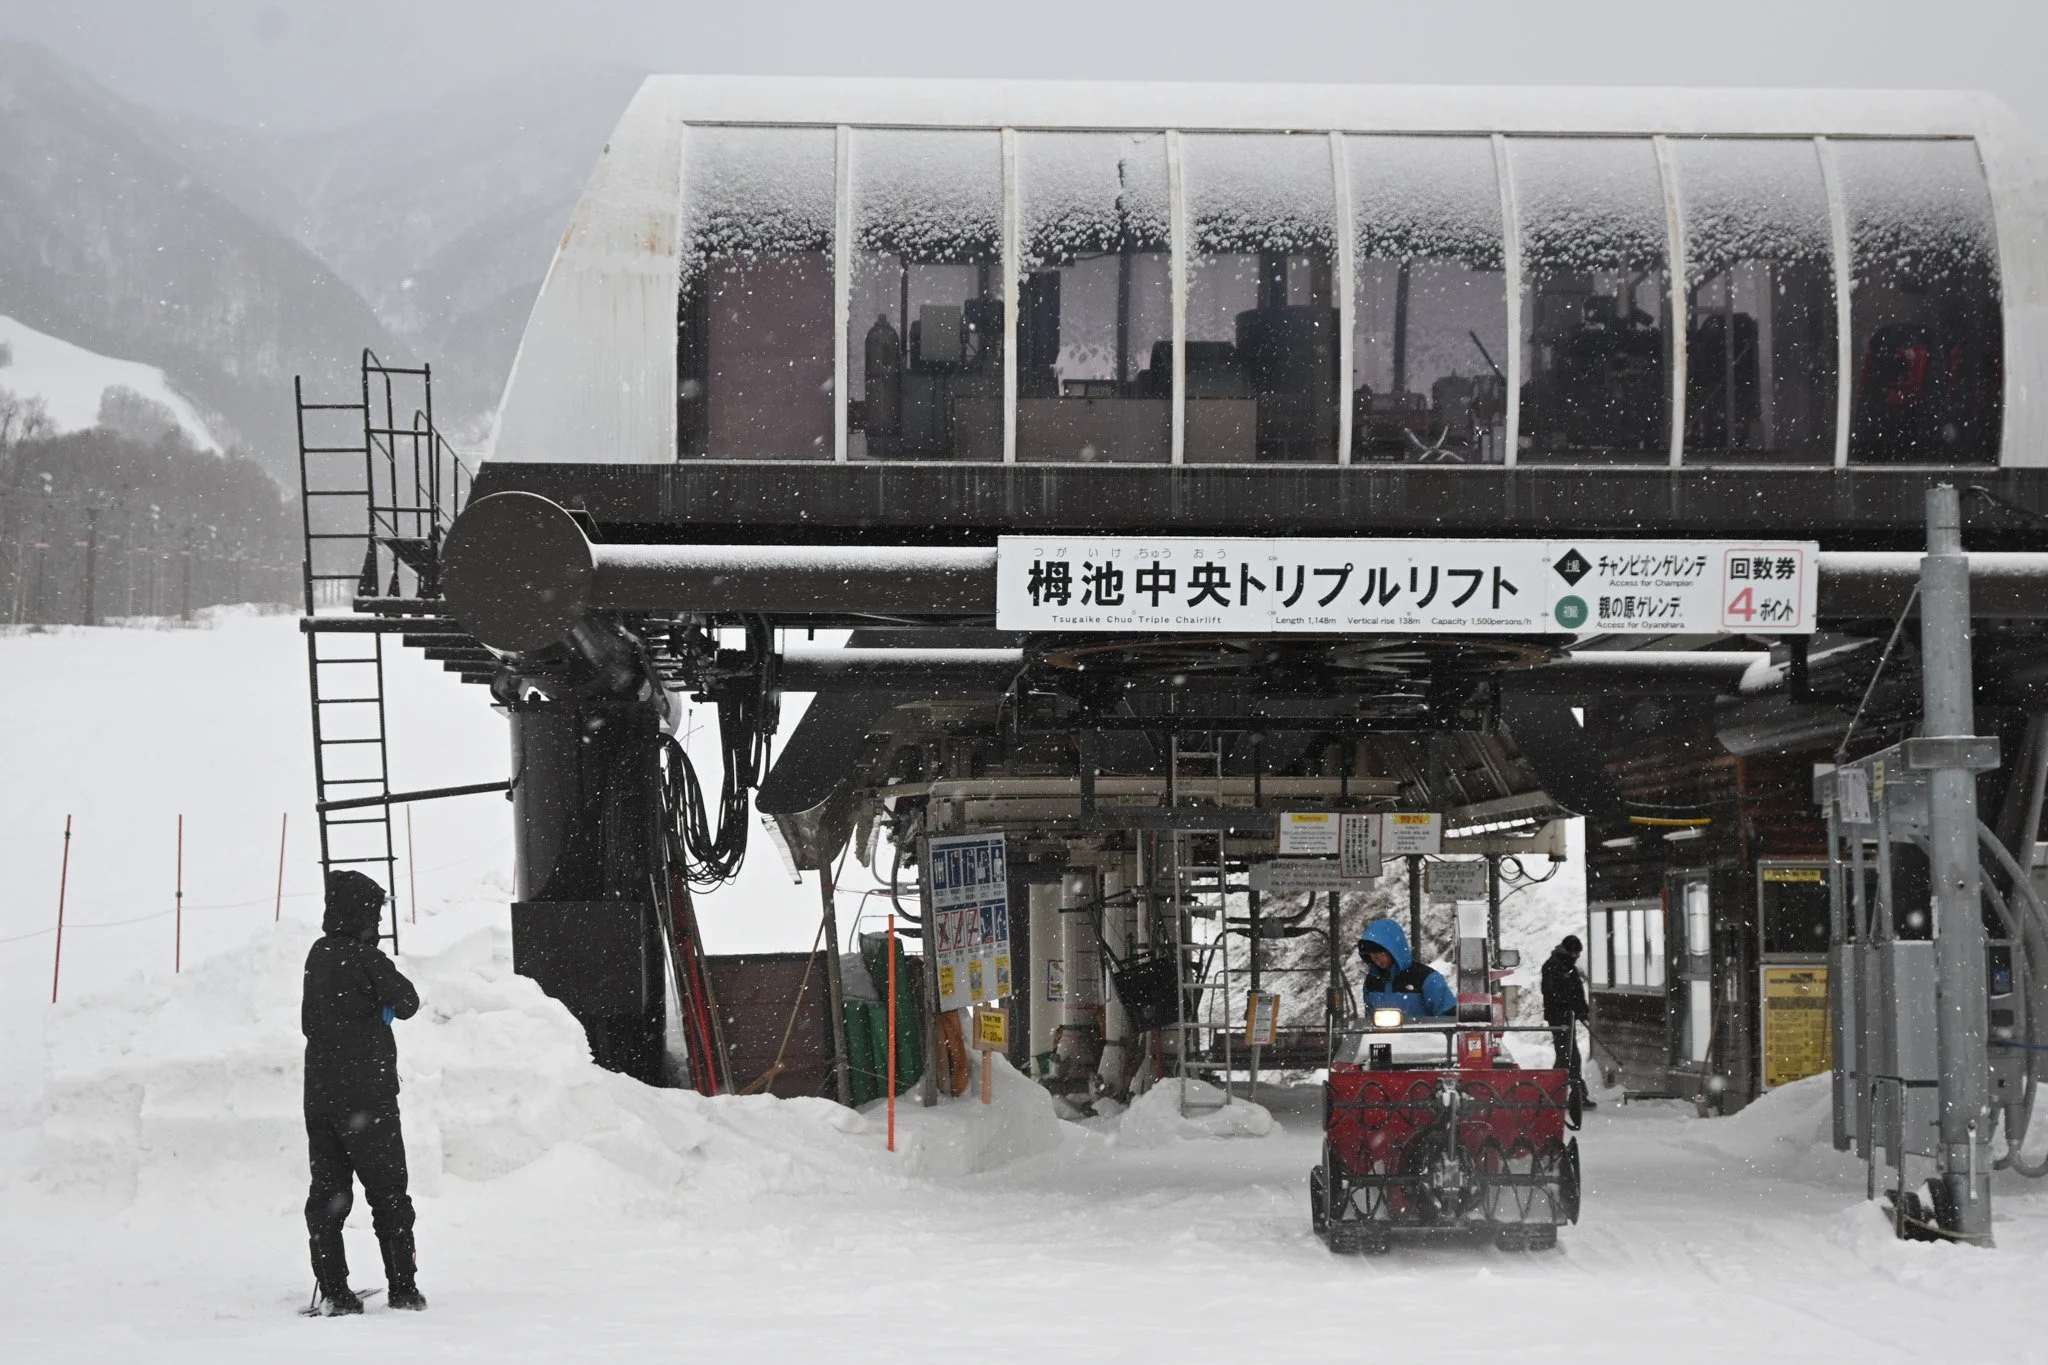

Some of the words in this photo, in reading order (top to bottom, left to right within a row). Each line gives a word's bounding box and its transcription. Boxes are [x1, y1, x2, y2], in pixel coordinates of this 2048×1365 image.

[1598, 554, 1708, 578] チャンピオンゲレンデ
[1730, 557, 1796, 580] 回数券
[1026, 559, 1519, 609] 栂池中央トリプルリフト
[1609, 579, 1639, 587] Access
[1641, 579, 1652, 587] for
[1655, 579, 1694, 588] Champion
[1598, 595, 1682, 619] 親の原ゲレンデ
[1052, 615, 1101, 624] Tsugaike
[1106, 615, 1133, 624] Chuo
[1138, 615, 1170, 624] Triple
[1175, 615, 1222, 624] Chairlift
[1275, 616, 1305, 625] Length
[1308, 616, 1337, 625] 1,148m
[1347, 616, 1379, 625] Vertical
[1380, 617, 1396, 625] rise
[1398, 616, 1421, 625] 138m
[1431, 617, 1467, 626] Capacity
[1470, 617, 1532, 626] 1,500persons/h
[1596, 621, 1626, 630] Access
[1628, 621, 1640, 629] for
[1642, 621, 1686, 631] Oyanohara
